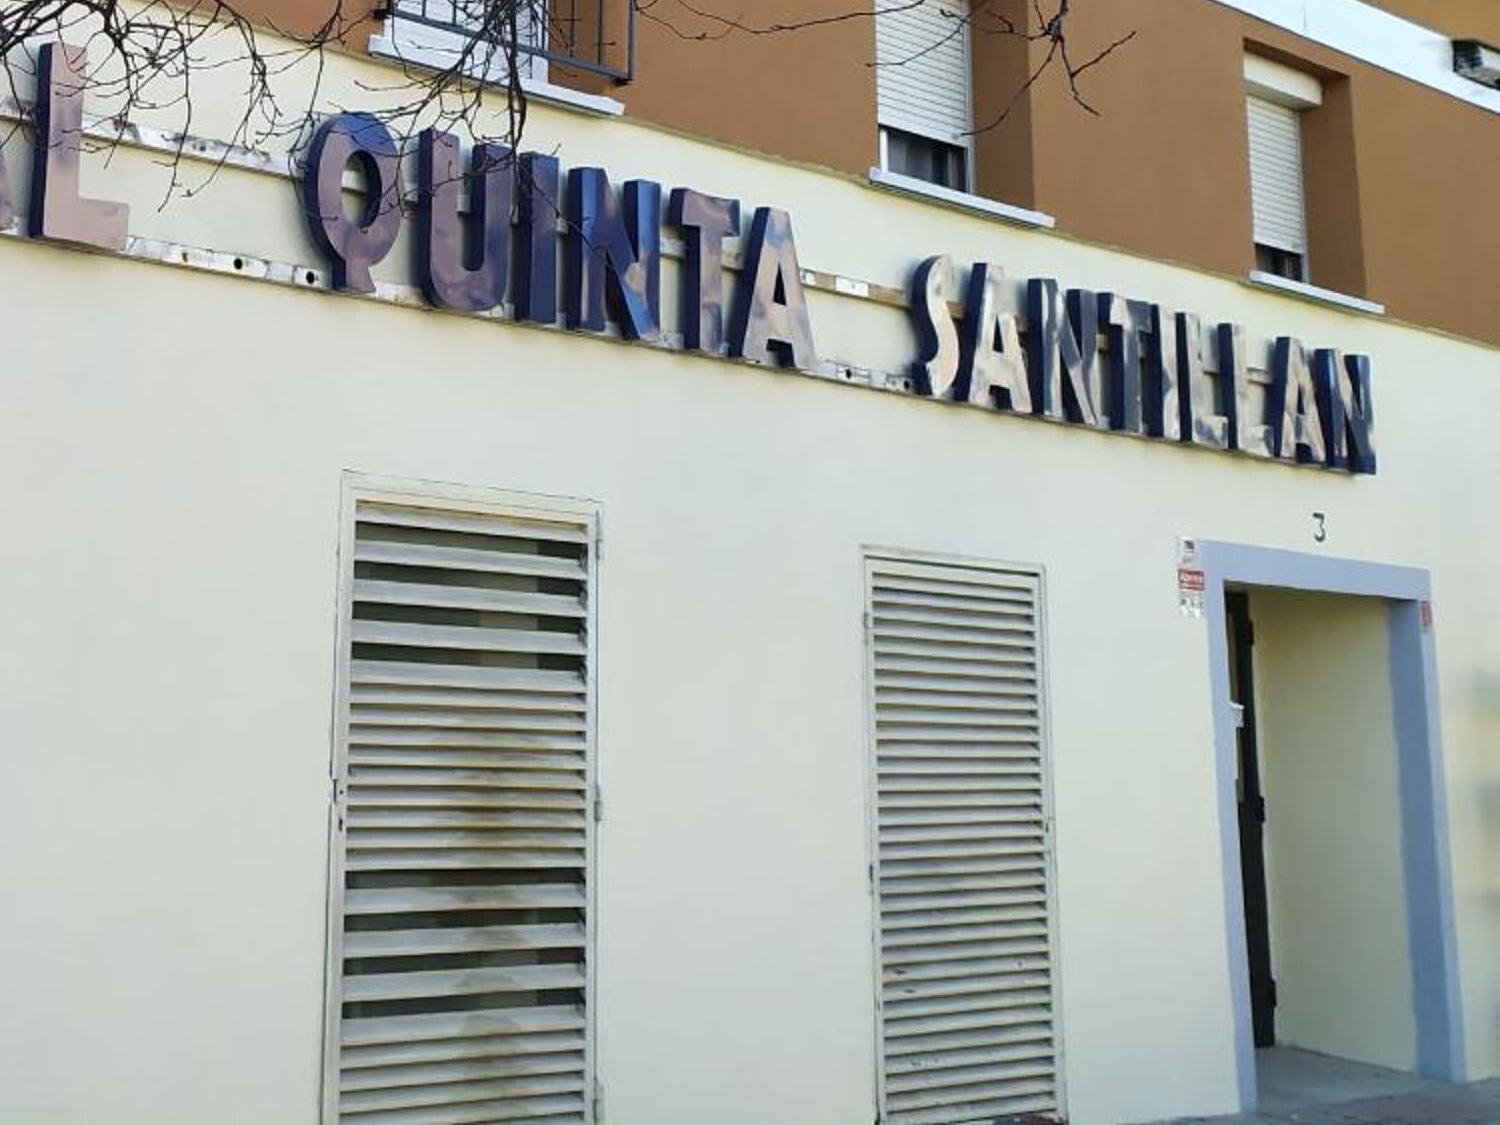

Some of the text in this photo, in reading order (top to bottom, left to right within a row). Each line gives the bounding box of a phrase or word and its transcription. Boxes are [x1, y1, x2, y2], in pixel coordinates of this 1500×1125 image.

[304, 111, 818, 371] QUINTA
[911, 253, 1377, 475] SANTILLAN
[1312, 511, 1327, 543] 3
